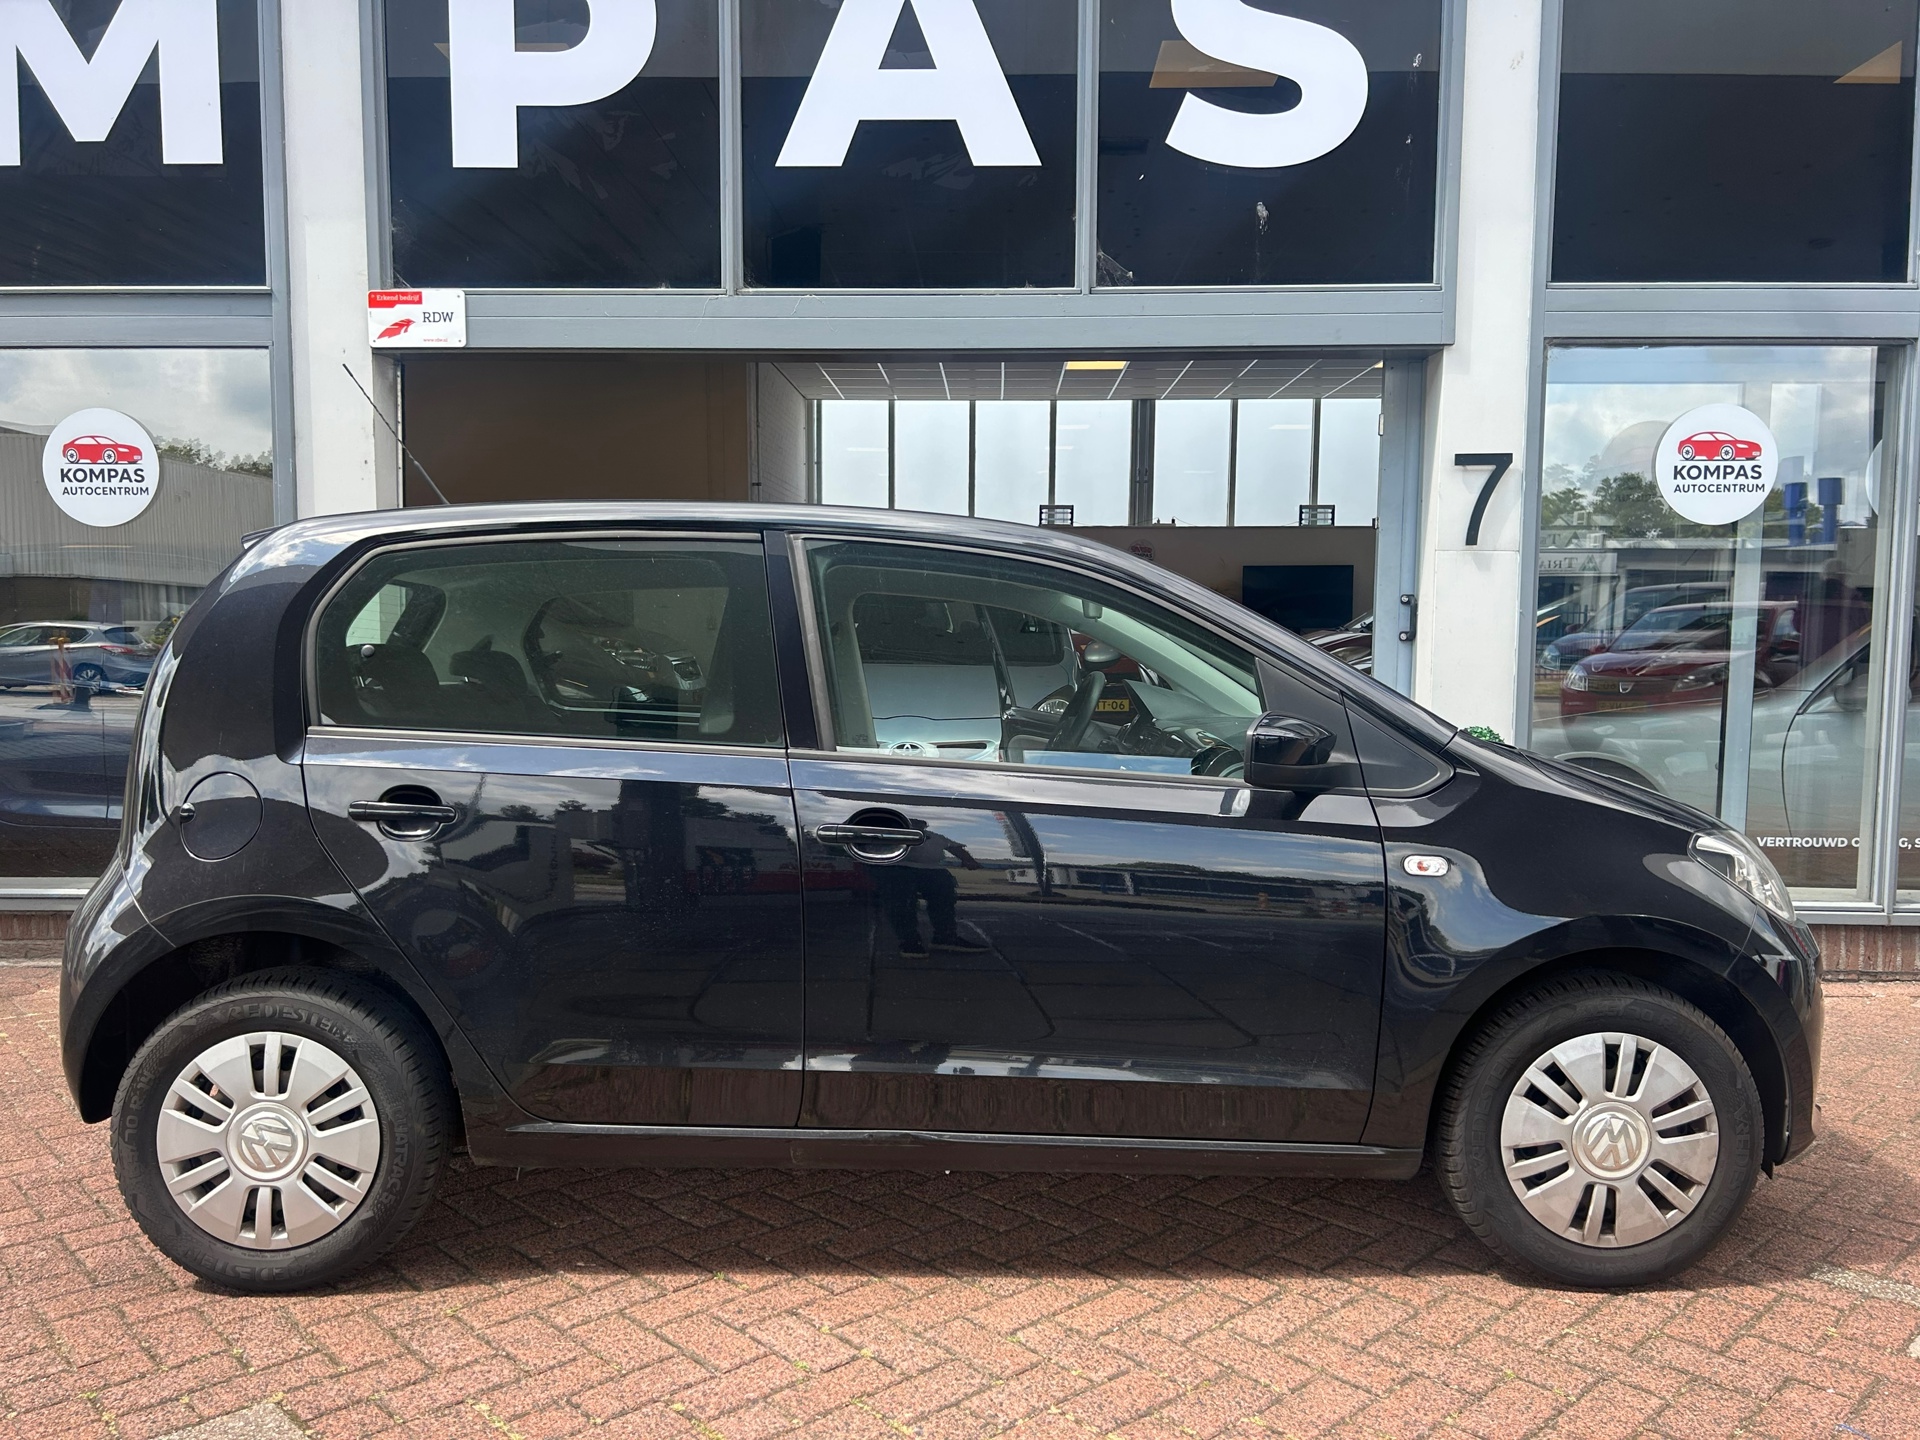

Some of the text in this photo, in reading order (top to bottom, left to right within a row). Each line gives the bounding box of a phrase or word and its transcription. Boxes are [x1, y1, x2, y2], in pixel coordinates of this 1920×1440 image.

[422, 311, 454, 323] RDW
[60, 468, 145, 483] KOMPAS
[1673, 465, 1762, 480] KOMPAS
[62, 487, 149, 496] AUTOCENTRUM
[1674, 484, 1765, 493] AUTOCENTRUM
[1454, 453, 1513, 545] 7
[1757, 837, 1848, 848] VERTROUWD
